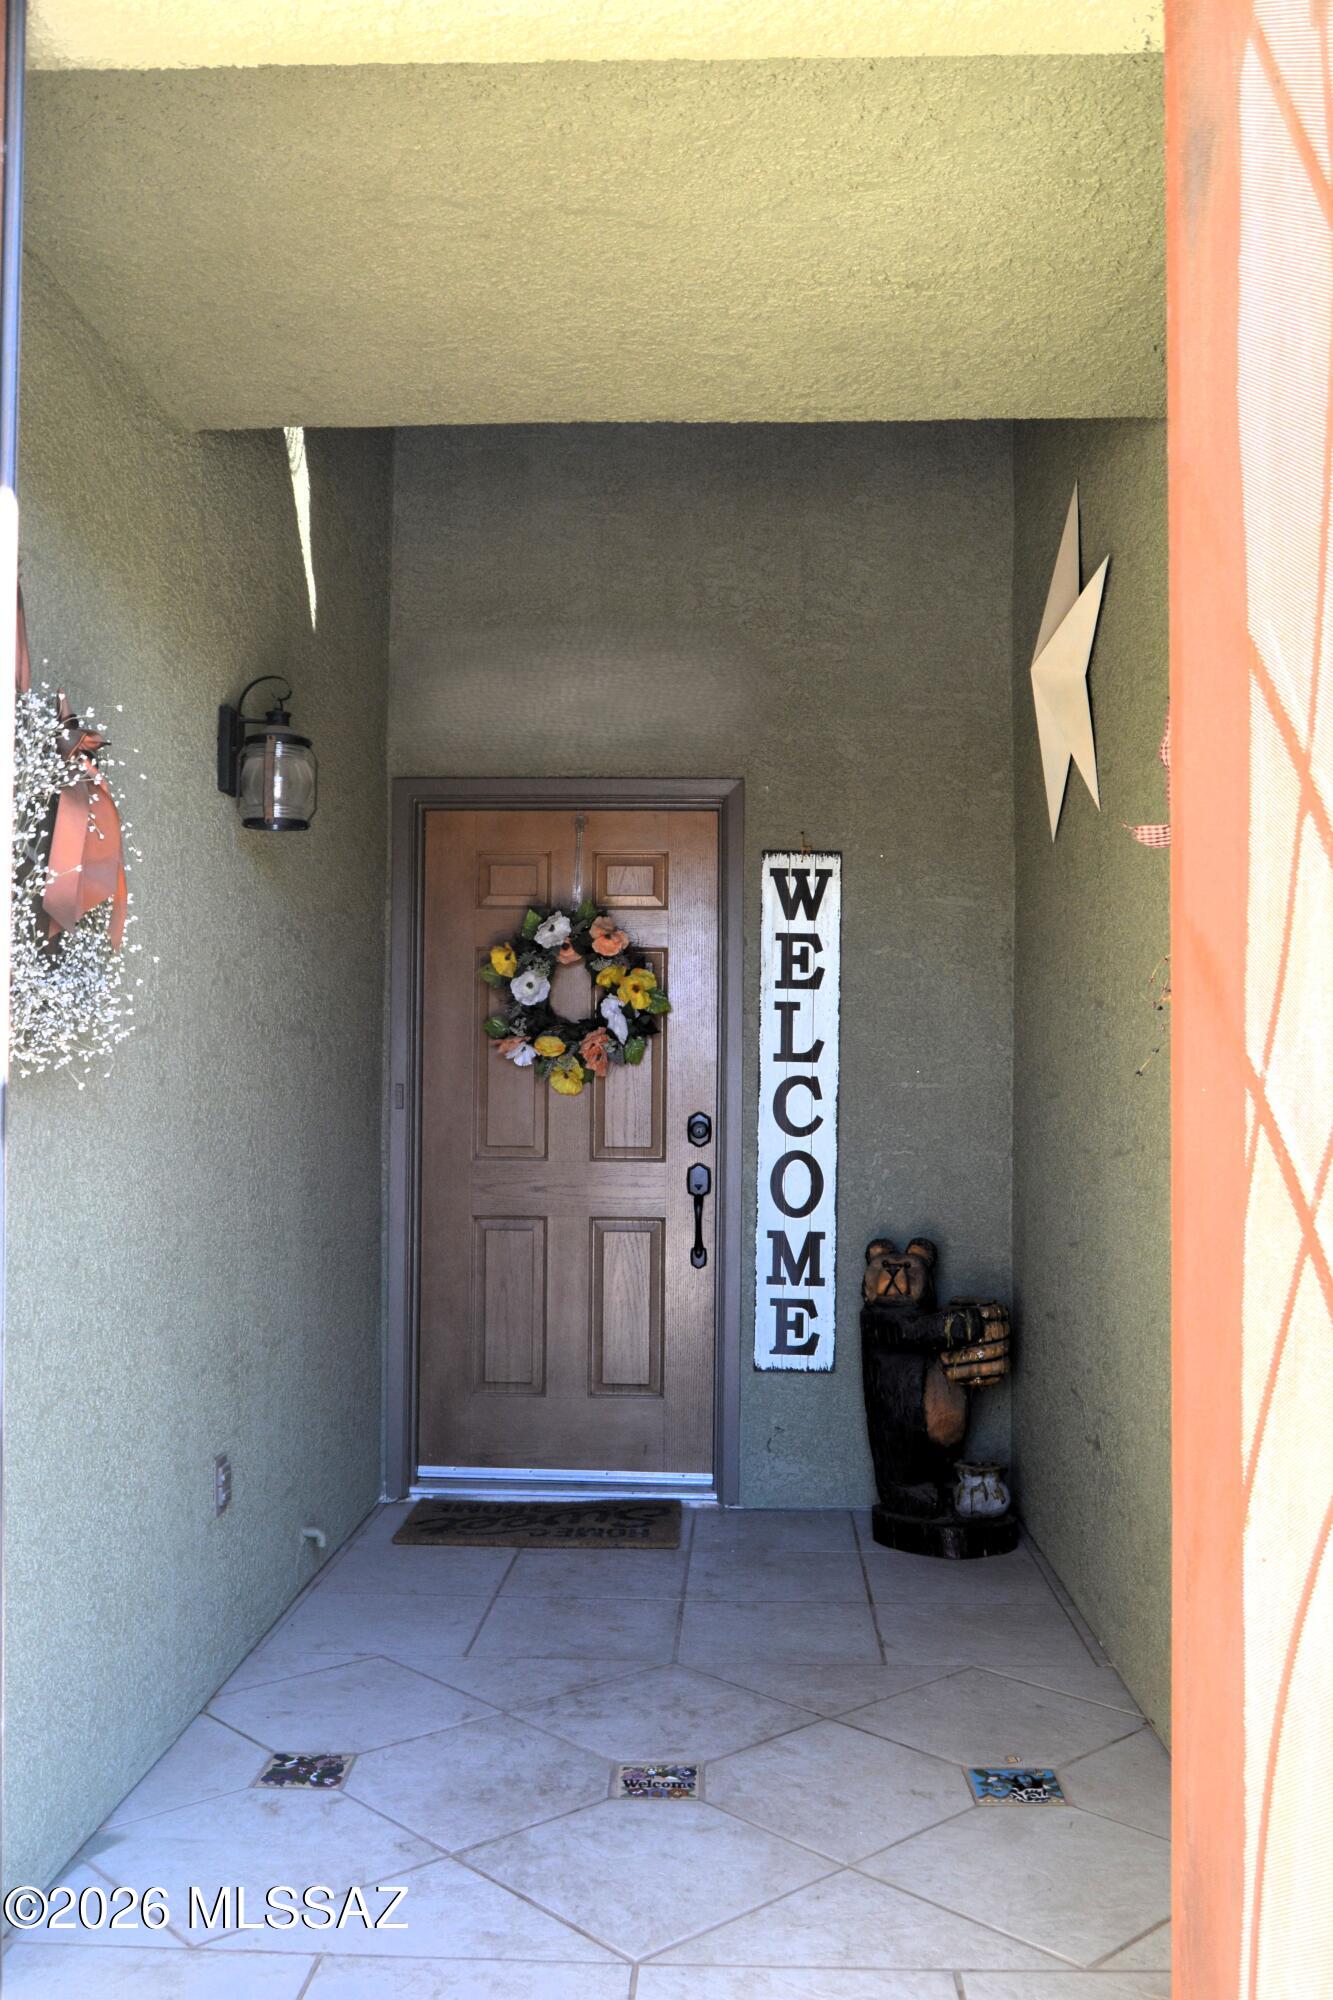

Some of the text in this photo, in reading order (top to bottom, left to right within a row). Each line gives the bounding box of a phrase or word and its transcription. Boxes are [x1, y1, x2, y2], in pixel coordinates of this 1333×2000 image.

[766, 868, 833, 1355] WELCOME
[552, 1528, 651, 1538] HOME
[622, 1779, 696, 1789] Welcome
